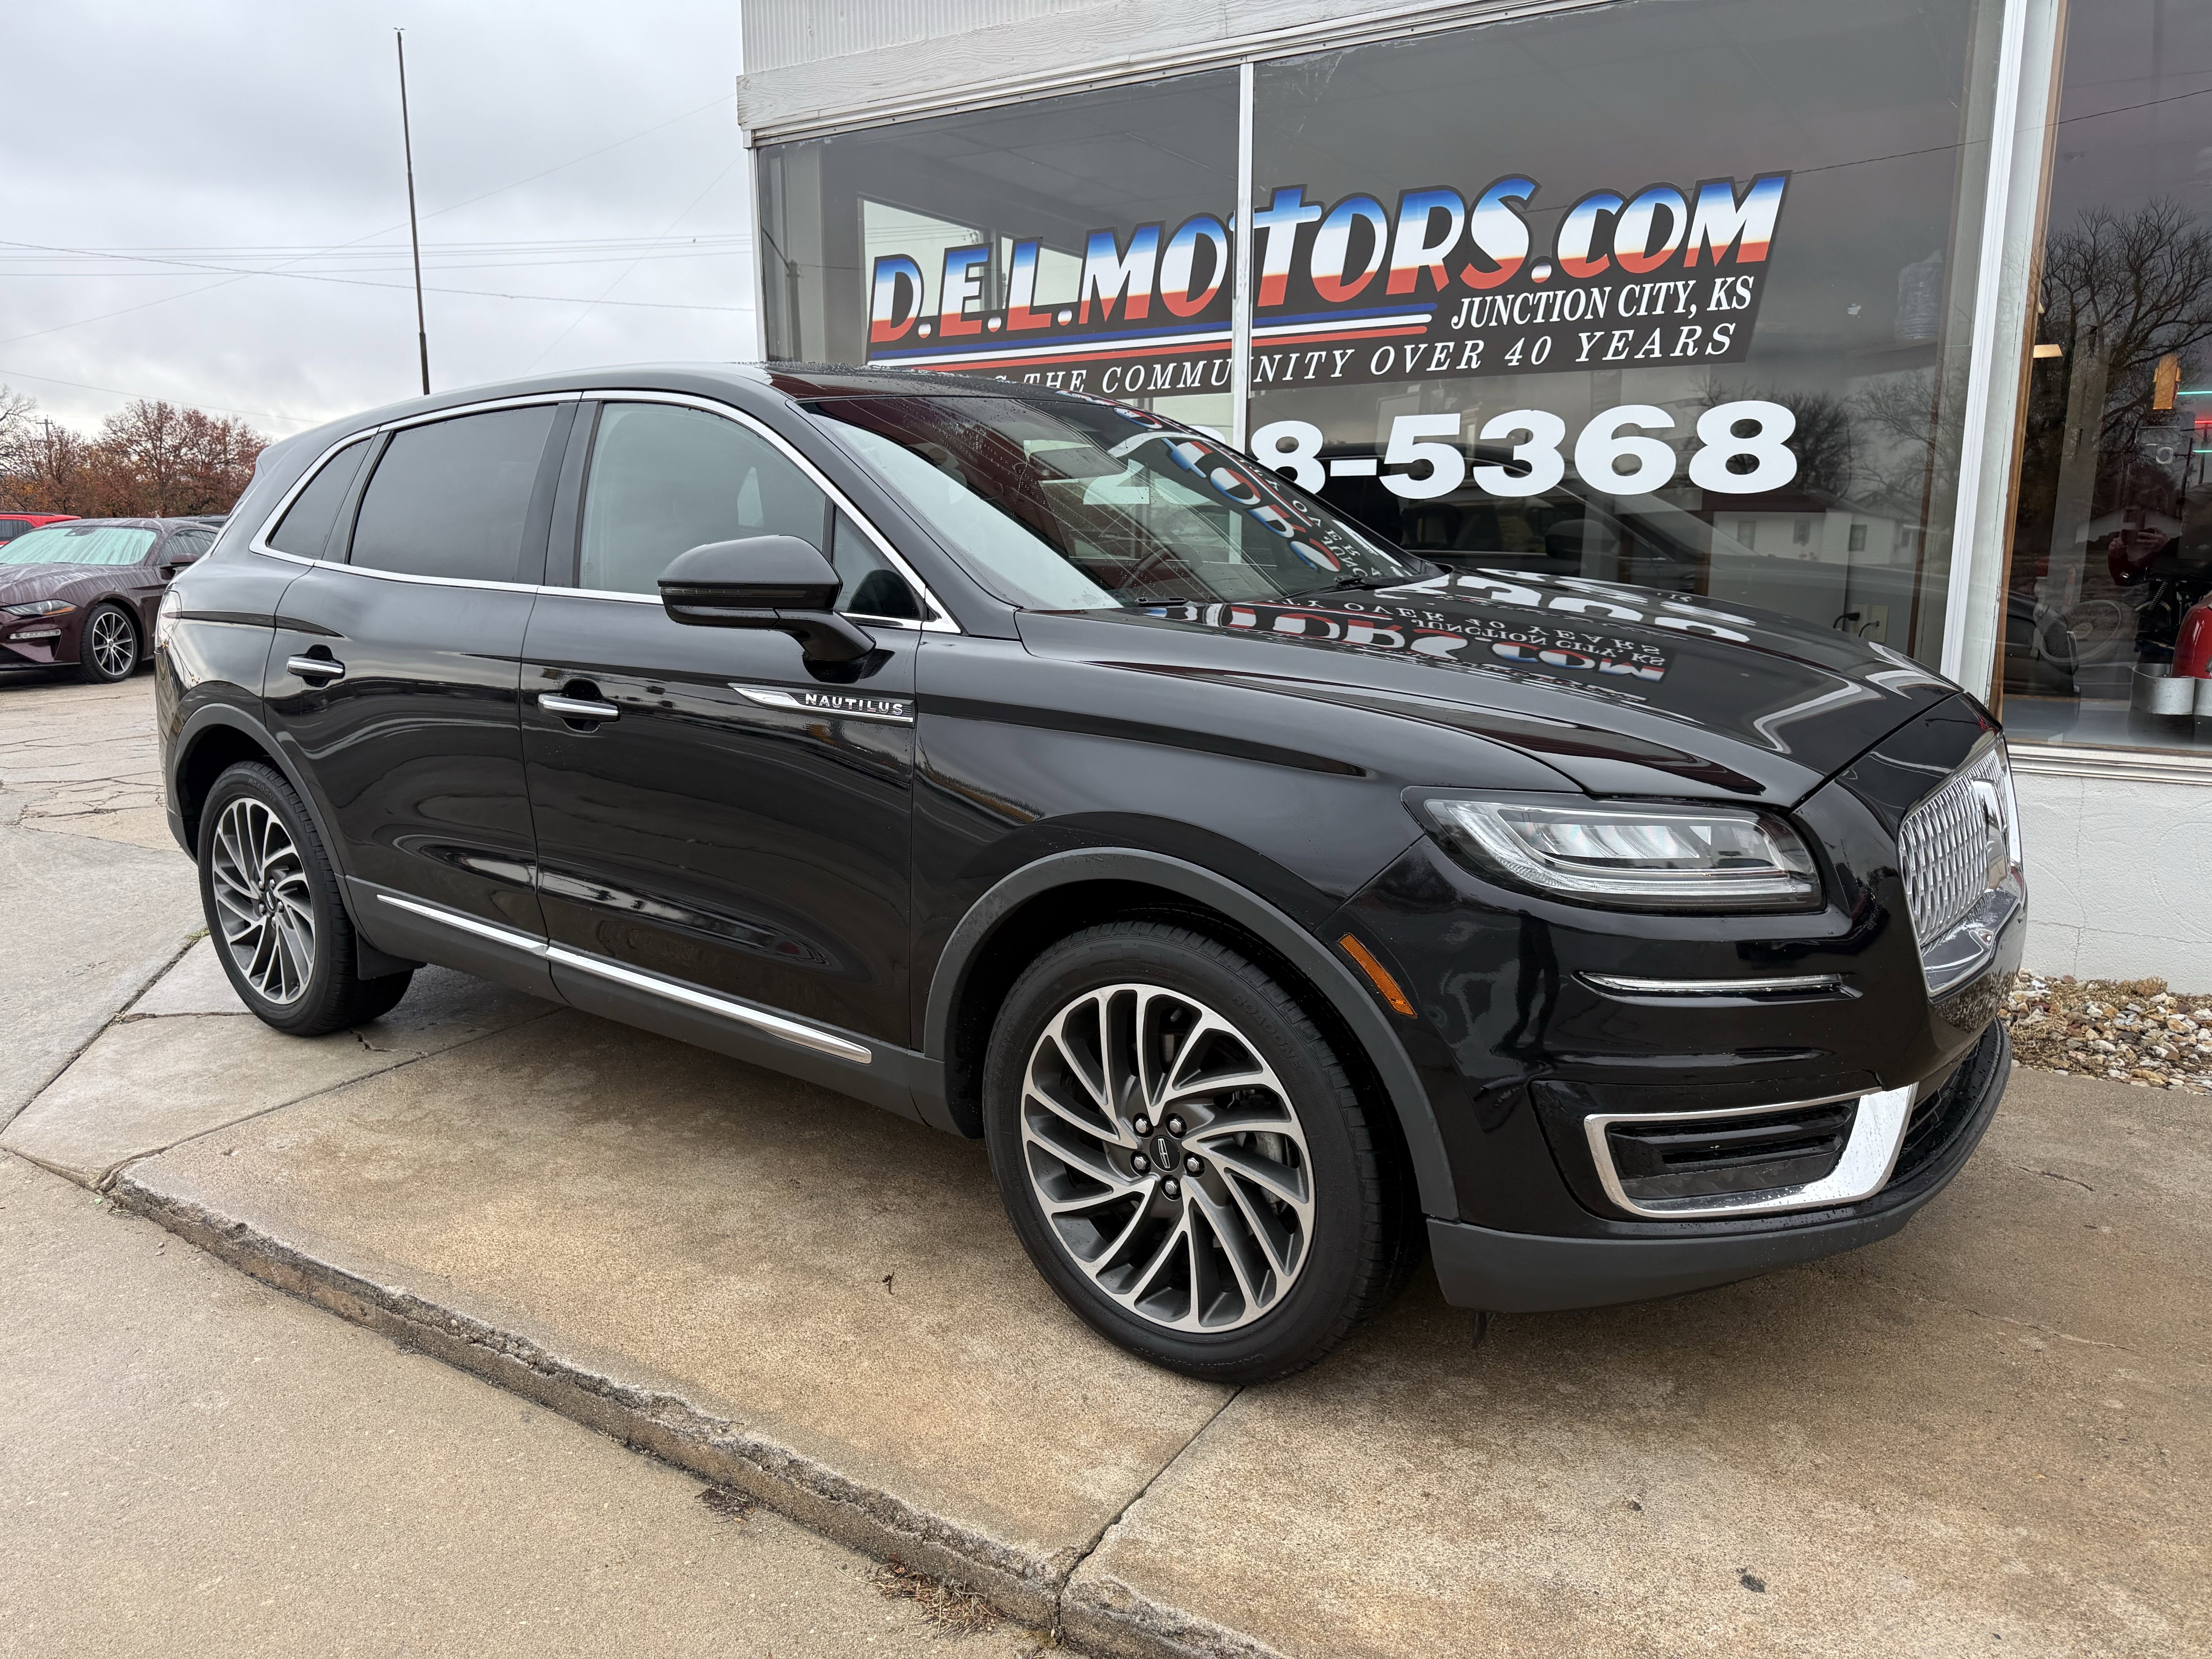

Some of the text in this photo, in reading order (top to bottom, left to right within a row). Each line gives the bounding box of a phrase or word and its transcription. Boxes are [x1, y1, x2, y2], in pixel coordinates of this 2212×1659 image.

[1451, 275, 1755, 330] JUNCTION CITY, KS
[1102, 350, 1354, 393] COMMUNITY
[1369, 339, 1485, 376] OVER
[1503, 335, 1553, 367] 40
[1575, 323, 1736, 363] YEARS
[1187, 400, 1798, 500] 8-5368
[805, 693, 903, 716] NAUTILUS
